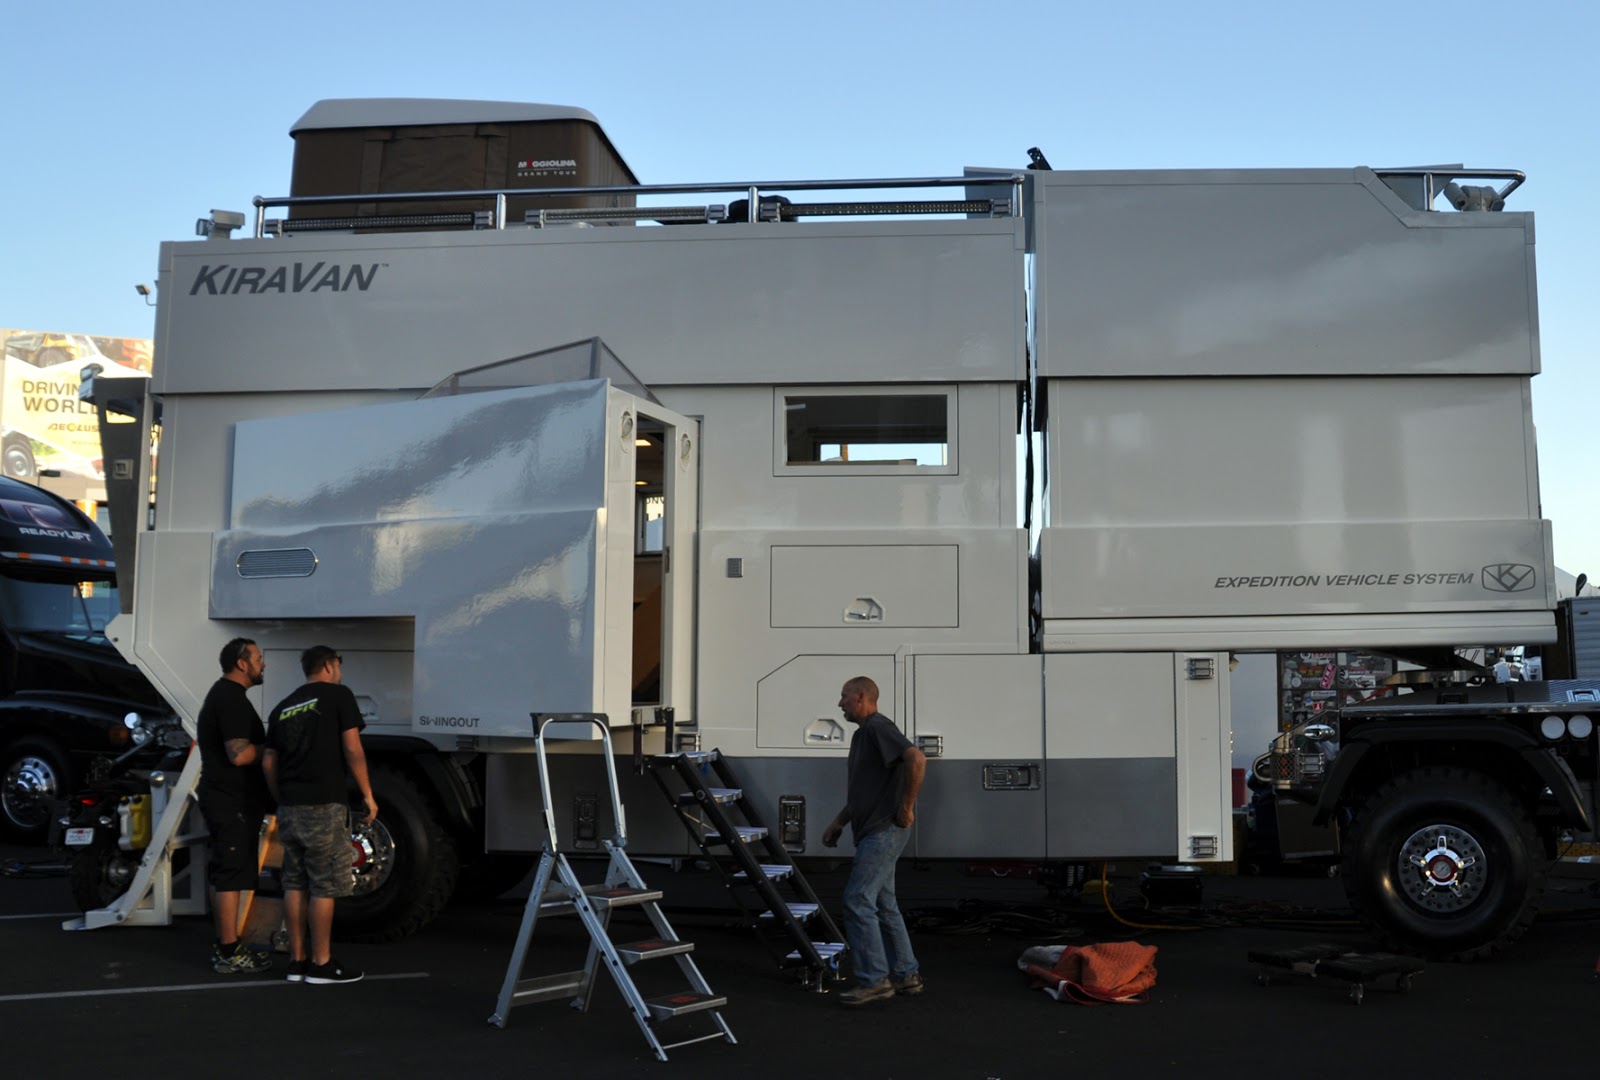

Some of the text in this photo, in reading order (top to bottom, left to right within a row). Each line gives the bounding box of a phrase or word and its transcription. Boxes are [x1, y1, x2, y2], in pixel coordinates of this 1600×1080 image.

[19, 527, 91, 541] READYLIFT
[1214, 575, 1321, 588] EXPEDITION
[1326, 574, 1399, 586] VEHICLE
[1403, 573, 1475, 585] SYSTEM
[419, 716, 480, 728] SWINGOUT
